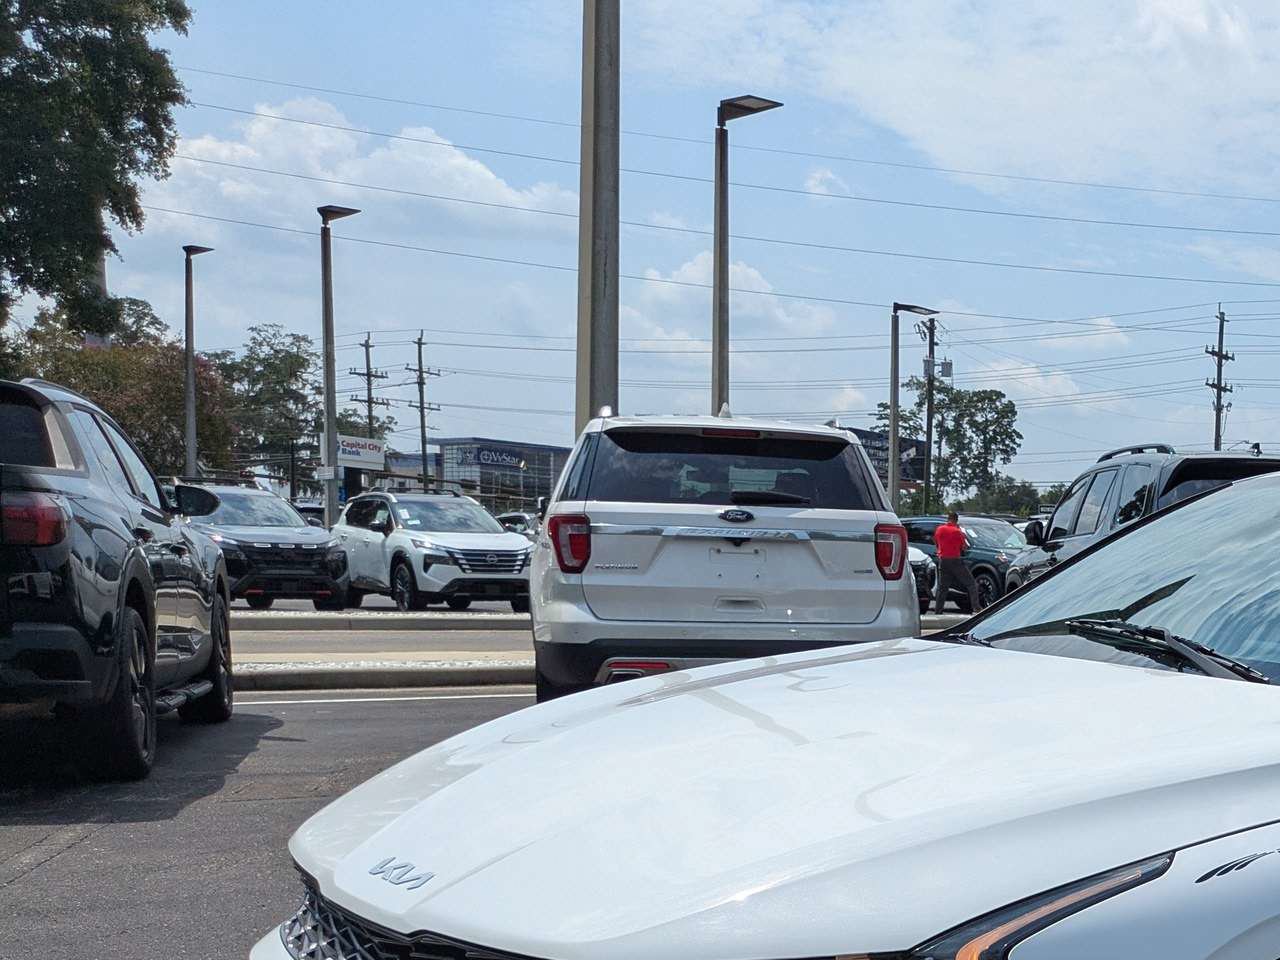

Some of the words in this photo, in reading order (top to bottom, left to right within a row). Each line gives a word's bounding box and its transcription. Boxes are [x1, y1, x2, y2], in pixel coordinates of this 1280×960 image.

[341, 440, 368, 450] Capital
[368, 442, 382, 453] City
[341, 447, 361, 456] Bank
